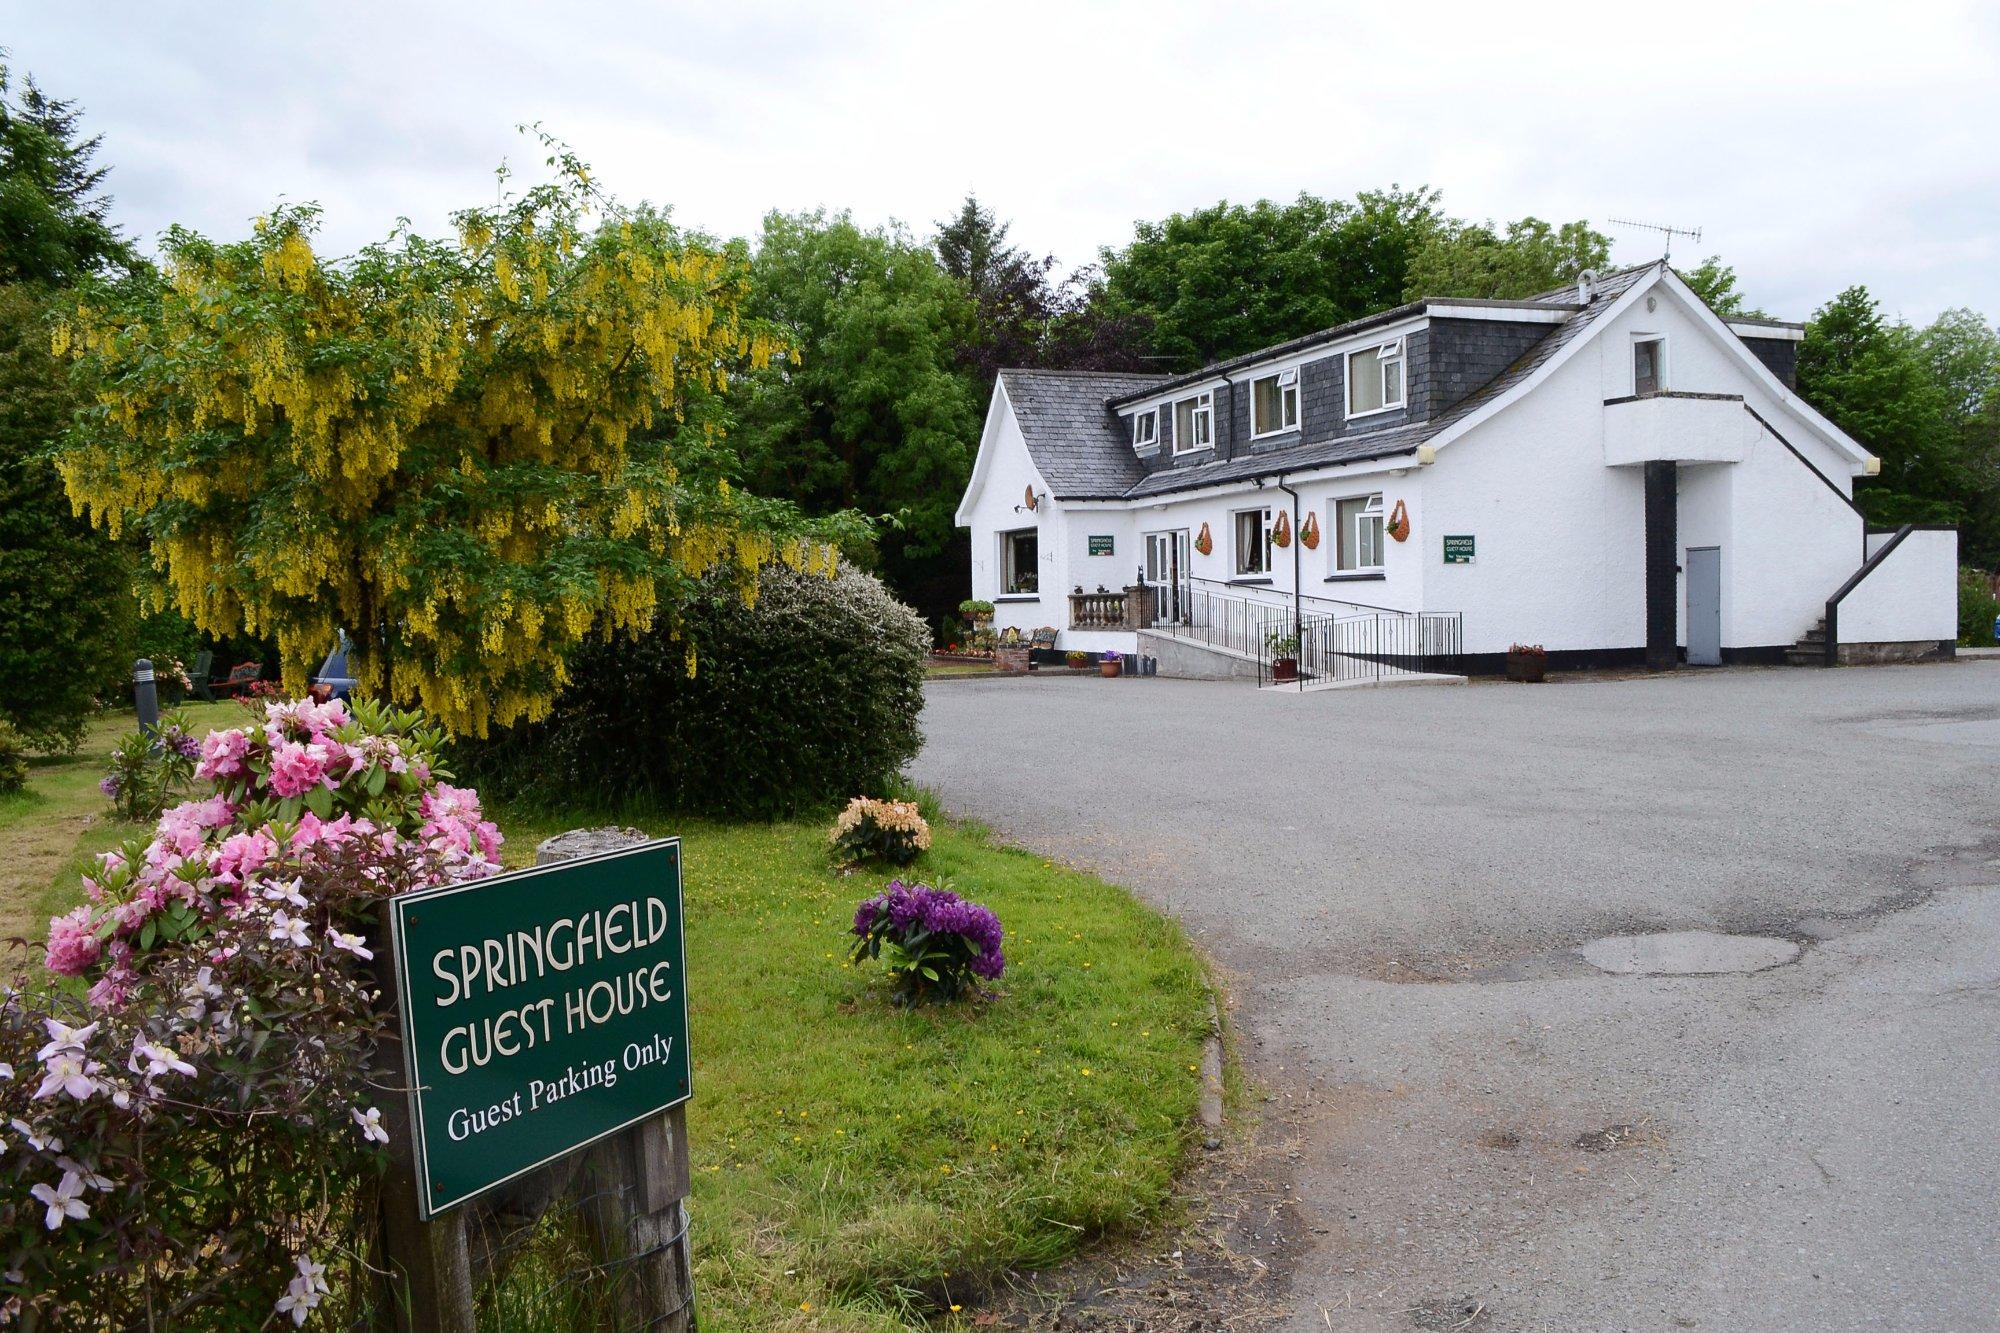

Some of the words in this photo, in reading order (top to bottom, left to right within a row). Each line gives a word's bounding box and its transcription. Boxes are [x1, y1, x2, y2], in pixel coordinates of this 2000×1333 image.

[433, 897, 667, 1006] SPRINGFIELD
[441, 998, 554, 1075] GUEST
[565, 961, 671, 1034] HOUSE
[448, 1091, 522, 1141] Guest
[529, 1058, 616, 1111] Parking
[623, 1034, 673, 1070] Only
